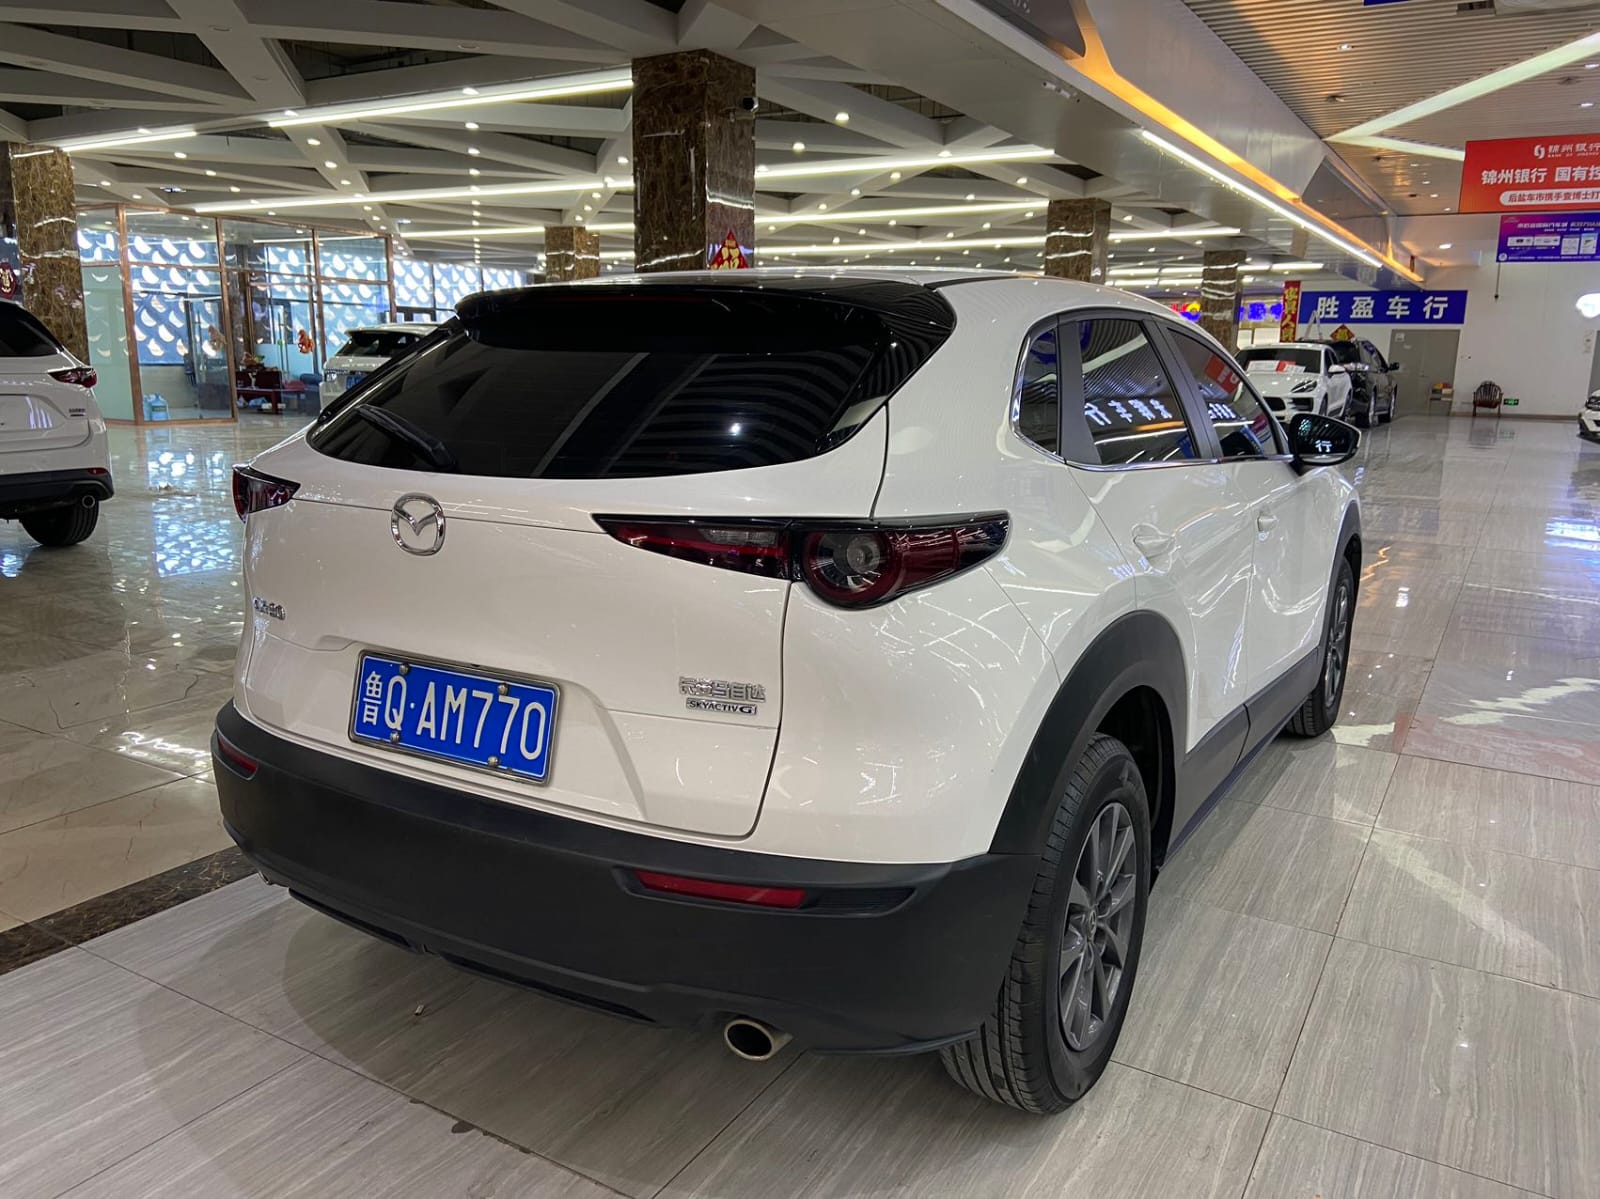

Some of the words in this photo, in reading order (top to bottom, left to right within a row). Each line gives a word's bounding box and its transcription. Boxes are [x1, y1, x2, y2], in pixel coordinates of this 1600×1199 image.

[1481, 167, 1548, 185] 锦州银行
[1315, 295, 1449, 320] 胜盈车行
